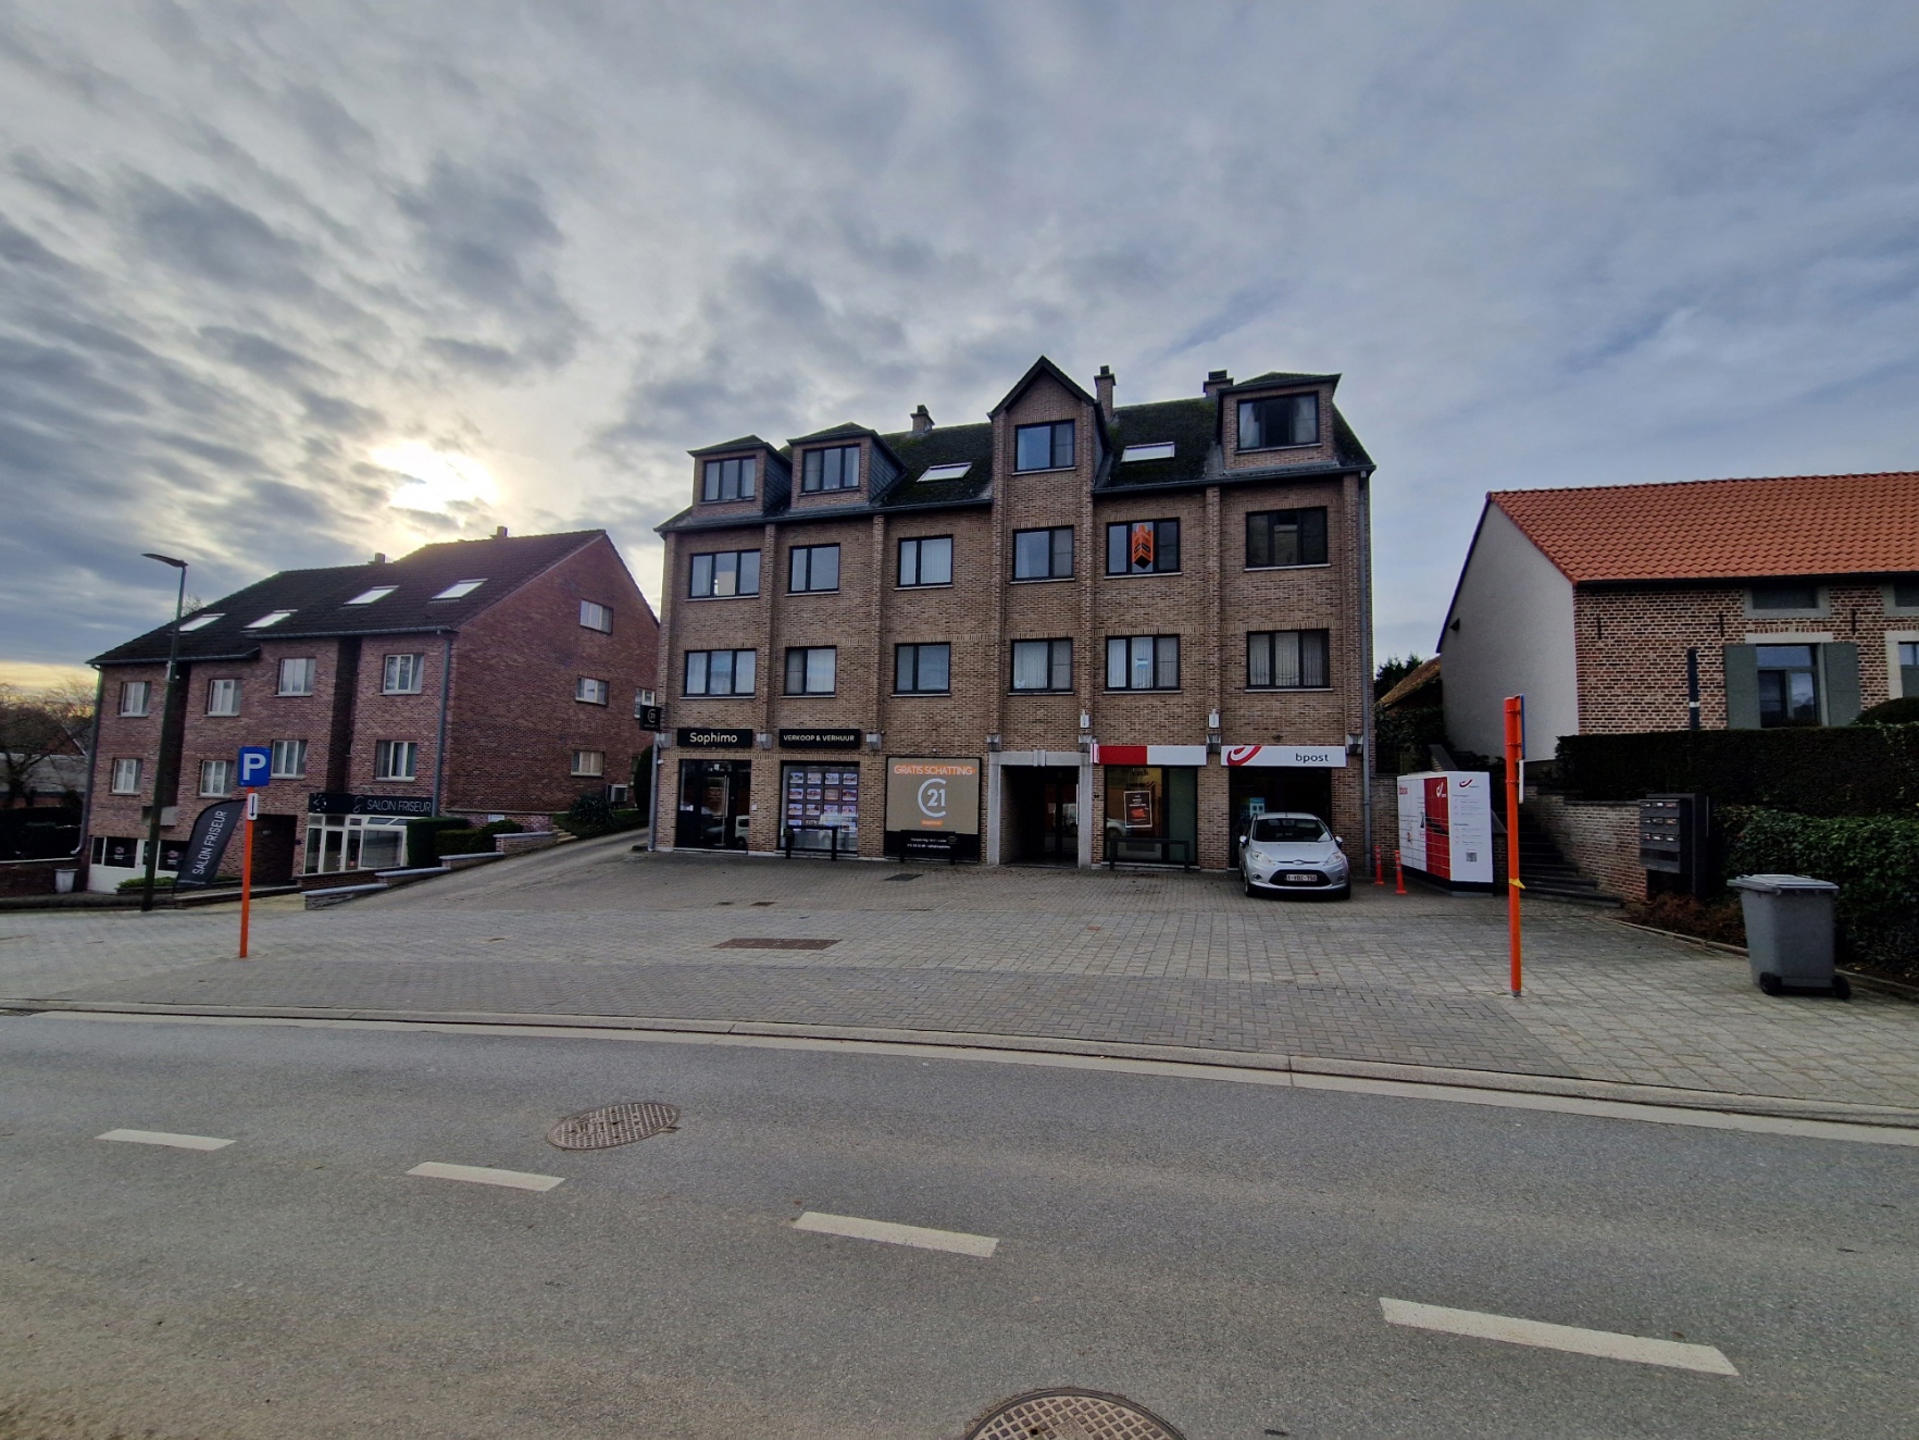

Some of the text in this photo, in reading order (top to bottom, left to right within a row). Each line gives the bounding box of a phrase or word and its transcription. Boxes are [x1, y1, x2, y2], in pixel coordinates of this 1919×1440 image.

[689, 732, 738, 745] Sophimo
[783, 734, 855, 742] VERKOOP & VERHUUR
[1295, 753, 1329, 764] bpost
[242, 753, 267, 781] P
[894, 765, 973, 776] GRATIS SCHATTING
[366, 799, 432, 812] SALON FRISEUR
[192, 847, 213, 875] SALON
[203, 810, 227, 849] FRISEUR
